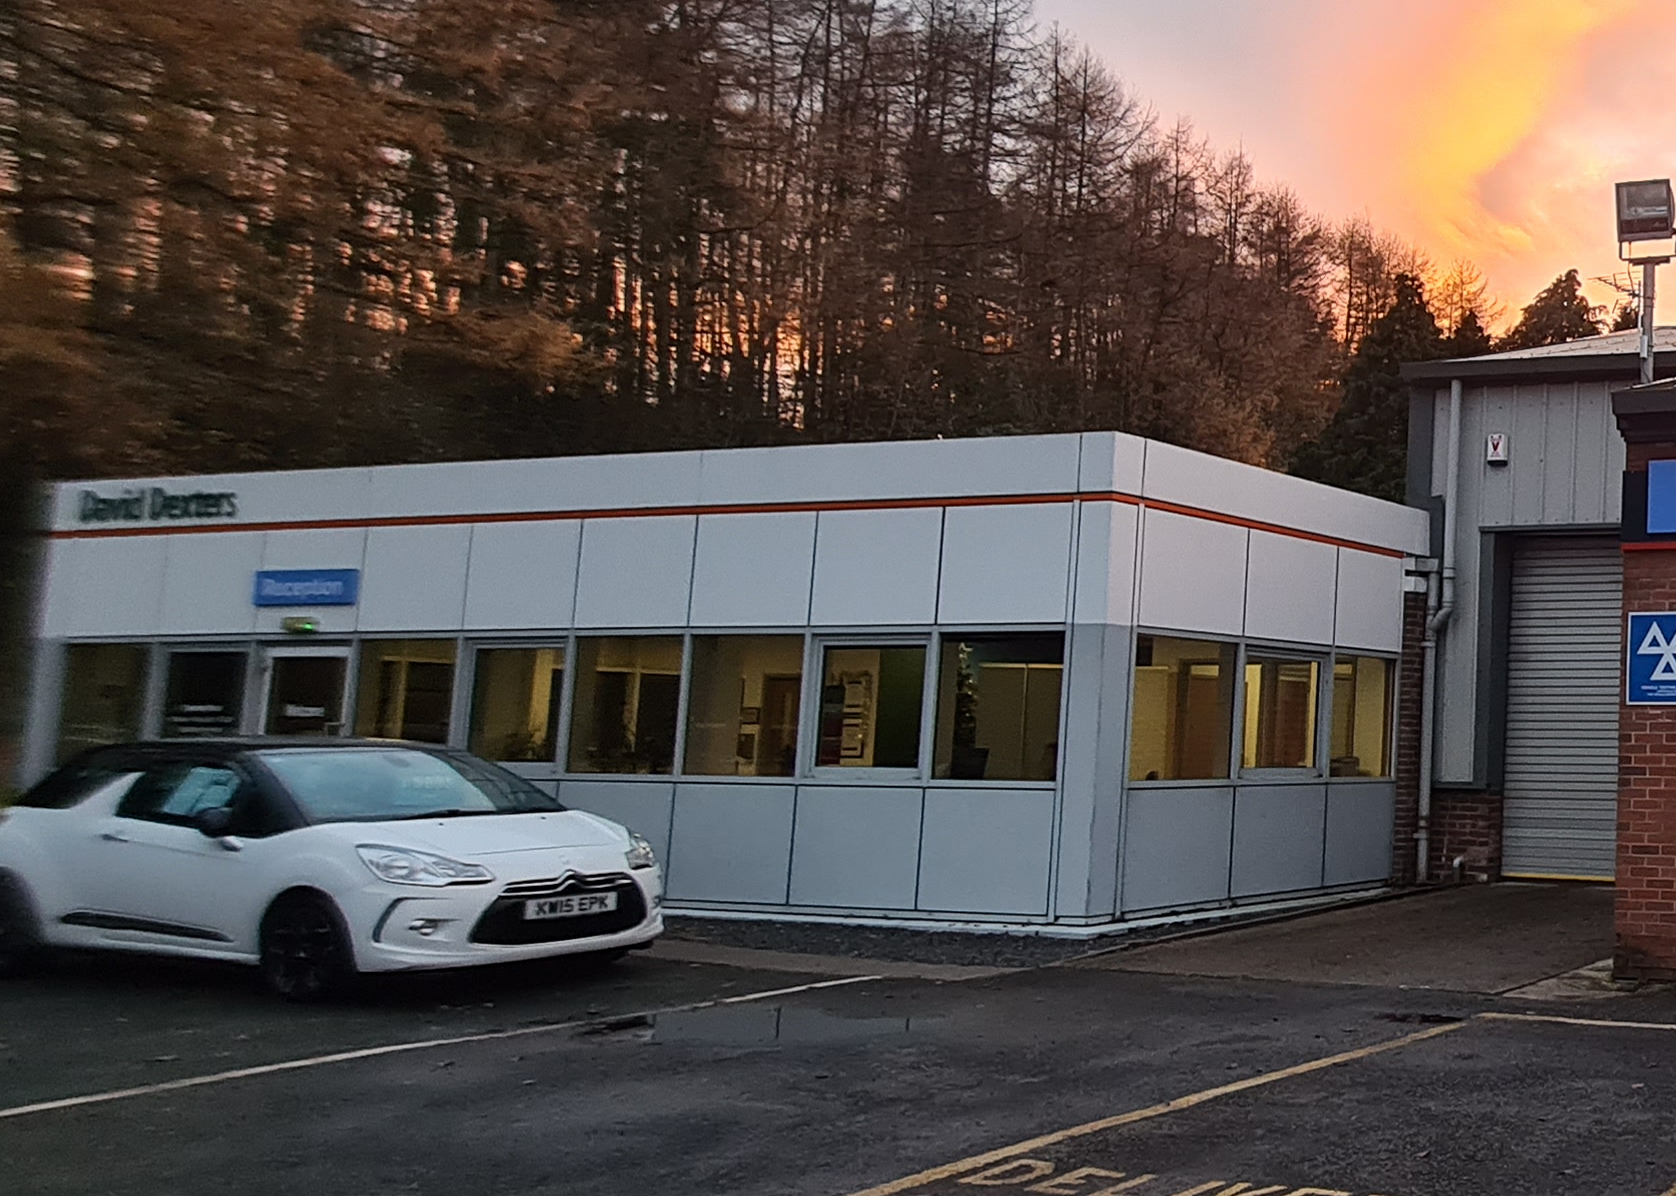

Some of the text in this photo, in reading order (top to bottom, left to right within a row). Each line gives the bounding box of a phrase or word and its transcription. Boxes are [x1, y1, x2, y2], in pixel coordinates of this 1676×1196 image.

[77, 487, 237, 522] David Dexters
[578, 895, 608, 912] EPK
